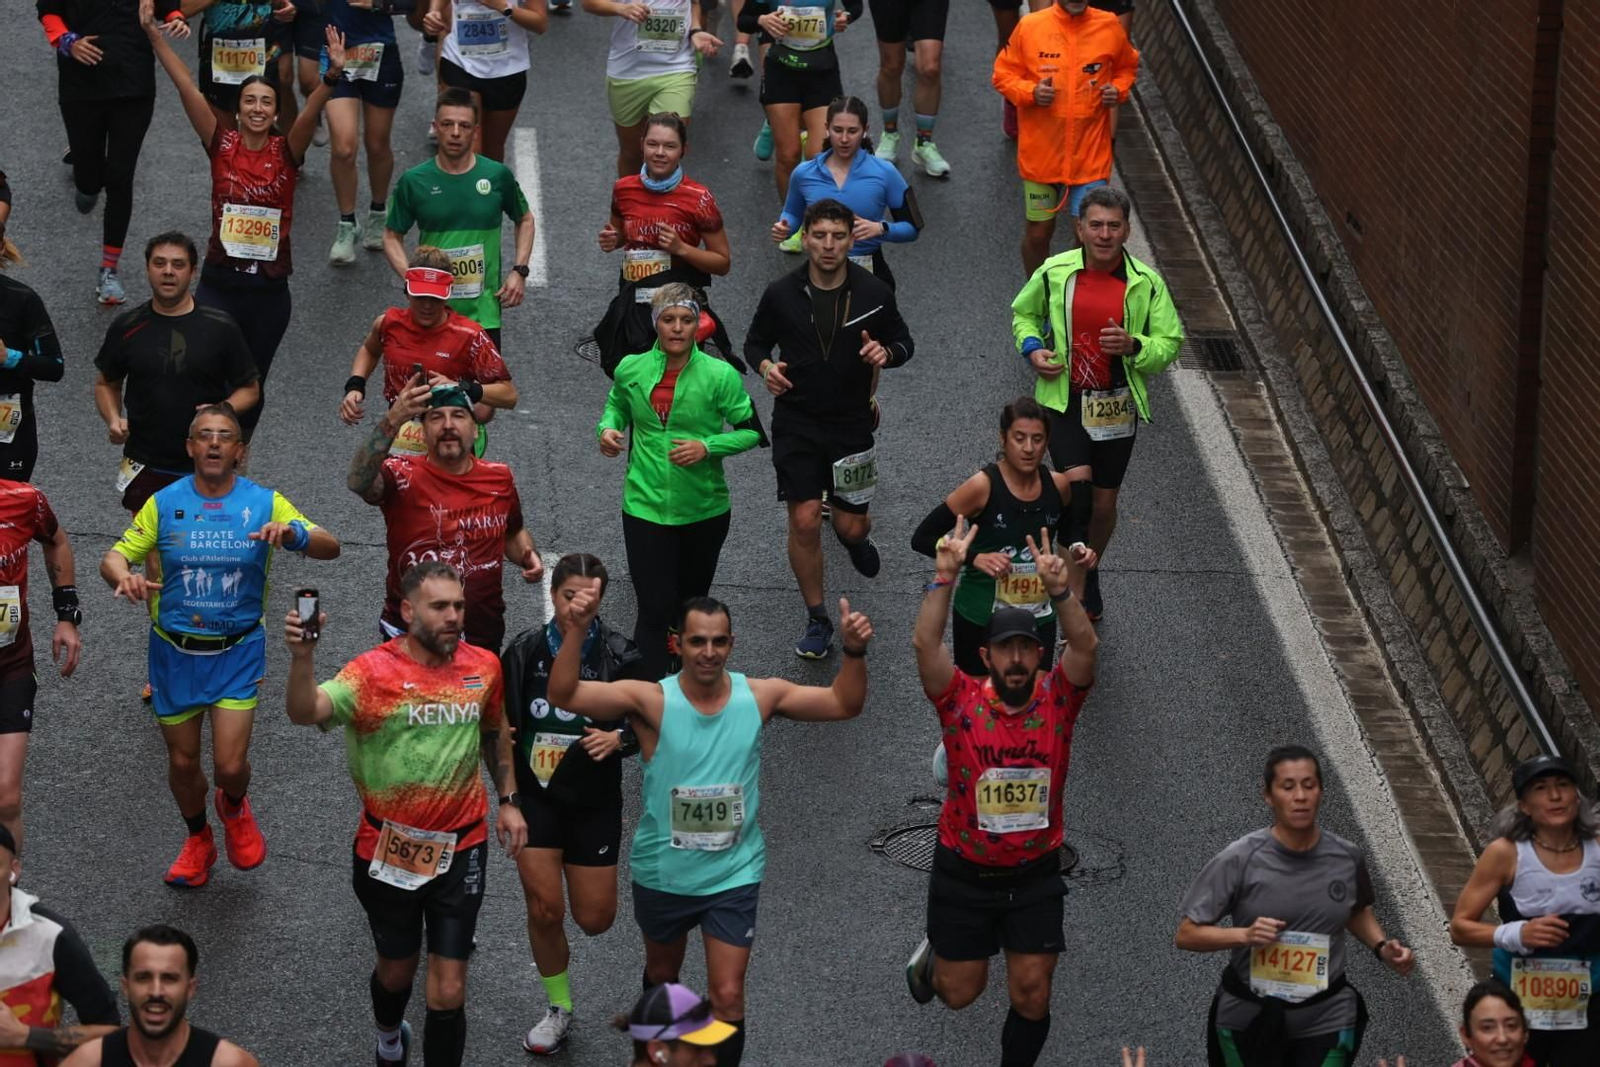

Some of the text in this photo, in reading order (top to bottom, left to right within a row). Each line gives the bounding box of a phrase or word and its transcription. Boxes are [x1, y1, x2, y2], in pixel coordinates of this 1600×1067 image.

[463, 23, 495, 38] 2843
[645, 18, 677, 33] 8320
[218, 50, 256, 64] 11170
[227, 218, 271, 237] 13296
[1088, 399, 1128, 418] 12384
[190, 540, 256, 549] BARCELONA
[191, 530, 234, 540] ESTATE
[408, 702, 480, 725] KENYA
[983, 783, 1038, 803] 11637
[681, 801, 727, 822] 7419
[388, 836, 434, 864] 5673
[1258, 947, 1317, 973] 14127
[1518, 976, 1580, 999] 10890
